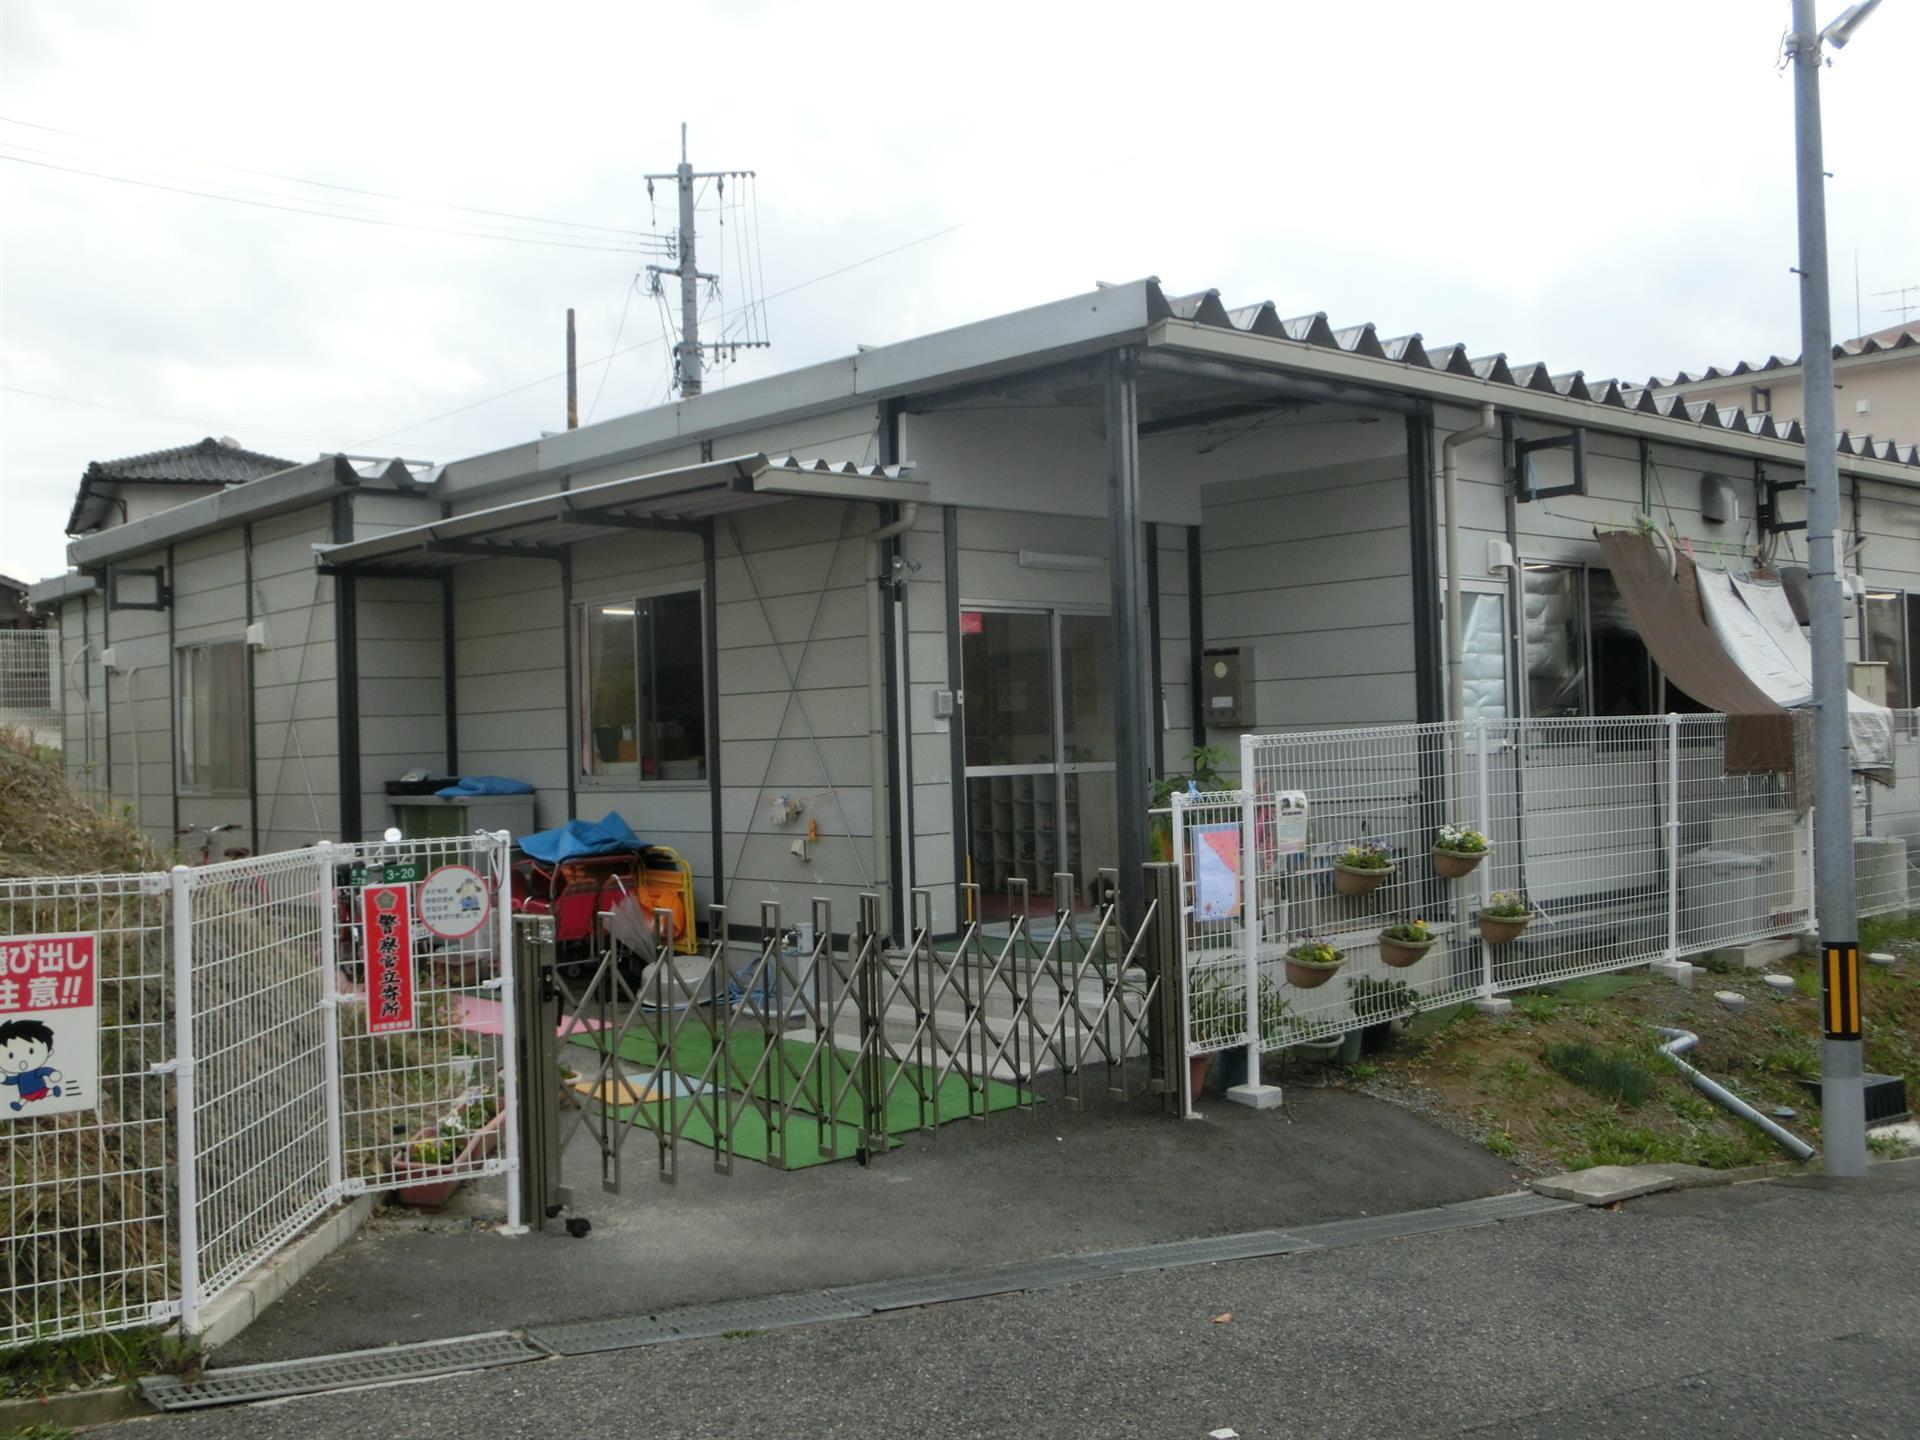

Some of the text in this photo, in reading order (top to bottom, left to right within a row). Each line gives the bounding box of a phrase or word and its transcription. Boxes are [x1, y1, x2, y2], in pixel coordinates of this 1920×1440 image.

[386, 868, 415, 880] 3-20
[0, 942, 88, 976] び出し
[378, 913, 400, 1018] 警察官立寄所
